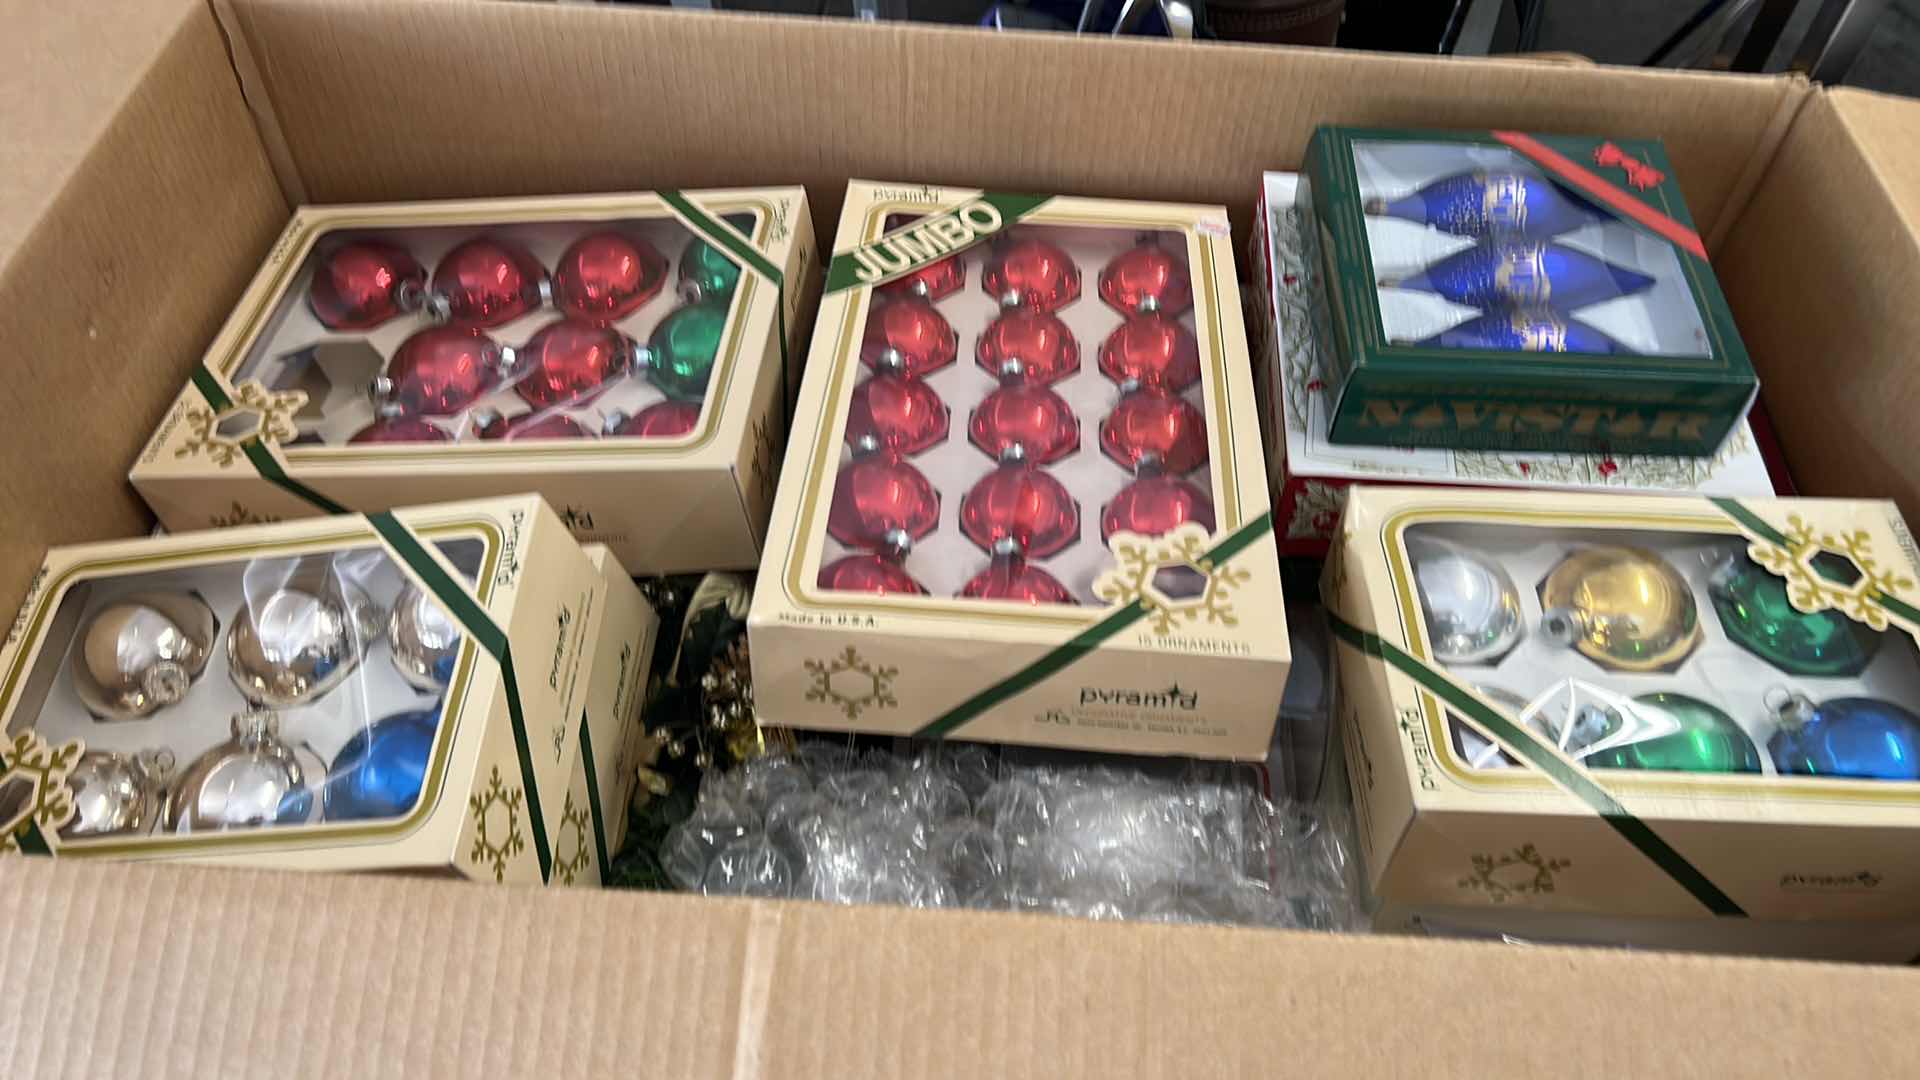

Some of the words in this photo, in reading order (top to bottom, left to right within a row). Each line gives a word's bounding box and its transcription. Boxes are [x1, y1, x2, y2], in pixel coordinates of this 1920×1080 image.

[855, 200, 1002, 281] JUMBO
[1359, 399, 1710, 440] NAVISTAR
[1079, 682, 1199, 711] pyramid
